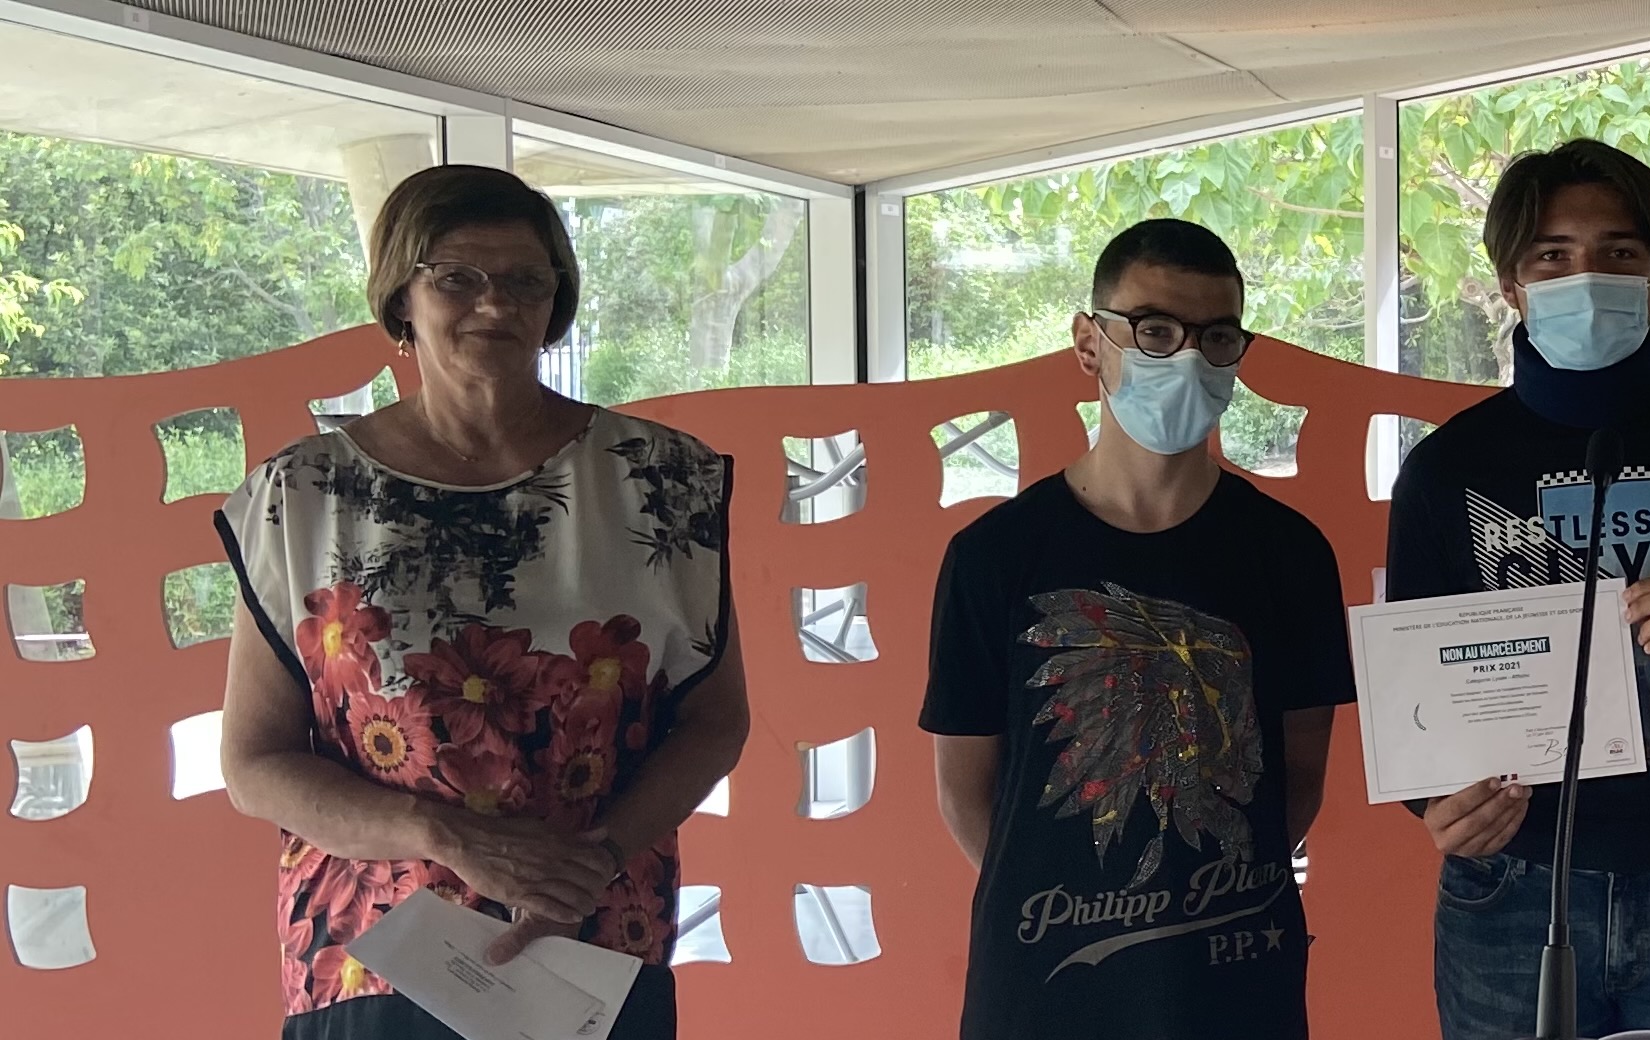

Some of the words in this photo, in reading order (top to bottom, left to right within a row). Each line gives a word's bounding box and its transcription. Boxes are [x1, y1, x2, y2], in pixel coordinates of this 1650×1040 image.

[1442, 647, 1464, 662] NON
[1465, 645, 1479, 660] AU
[1480, 638, 1547, 658] HARCÈLEMENT
[1473, 664, 1496, 674] PRIX
[1498, 661, 1520, 671] 2021
[1017, 884, 1171, 943] Philipp
[1208, 931, 1257, 965] P.P.
